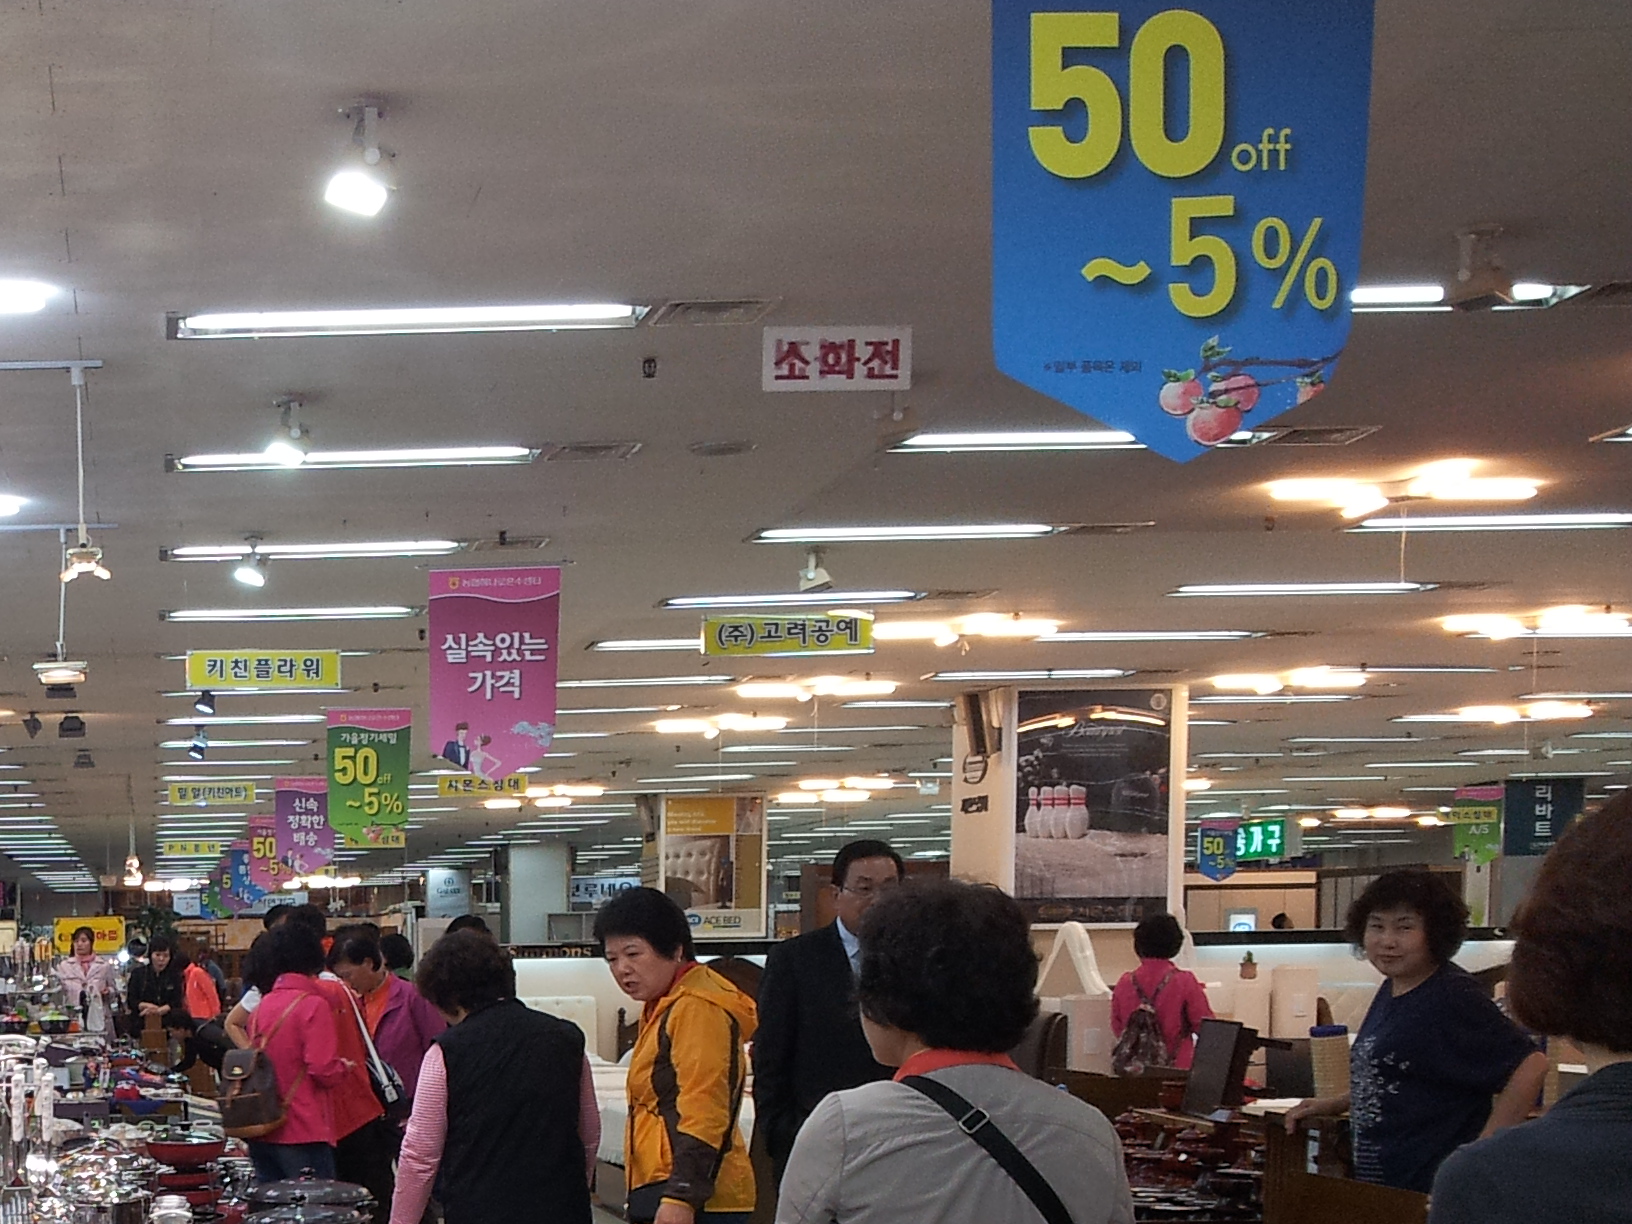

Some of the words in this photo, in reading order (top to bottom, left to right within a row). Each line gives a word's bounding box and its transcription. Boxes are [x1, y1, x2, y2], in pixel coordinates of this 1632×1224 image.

[1027, 8, 1226, 179] 50
[1230, 127, 1293, 172] off
[773, 337, 901, 382] 소화전
[440, 631, 550, 664] 실속있는
[718, 617, 860, 647] (주)고려공예
[206, 657, 322, 680] 키친플라워
[466, 669, 523, 701] 가격
[334, 747, 378, 785] 50
[292, 797, 319, 813] 신속
[1533, 784, 1554, 837] 리바트
[286, 814, 326, 830] 정확한
[292, 831, 319, 847] 배송
[703, 915, 722, 924] ACE
[723, 915, 742, 924] BED
